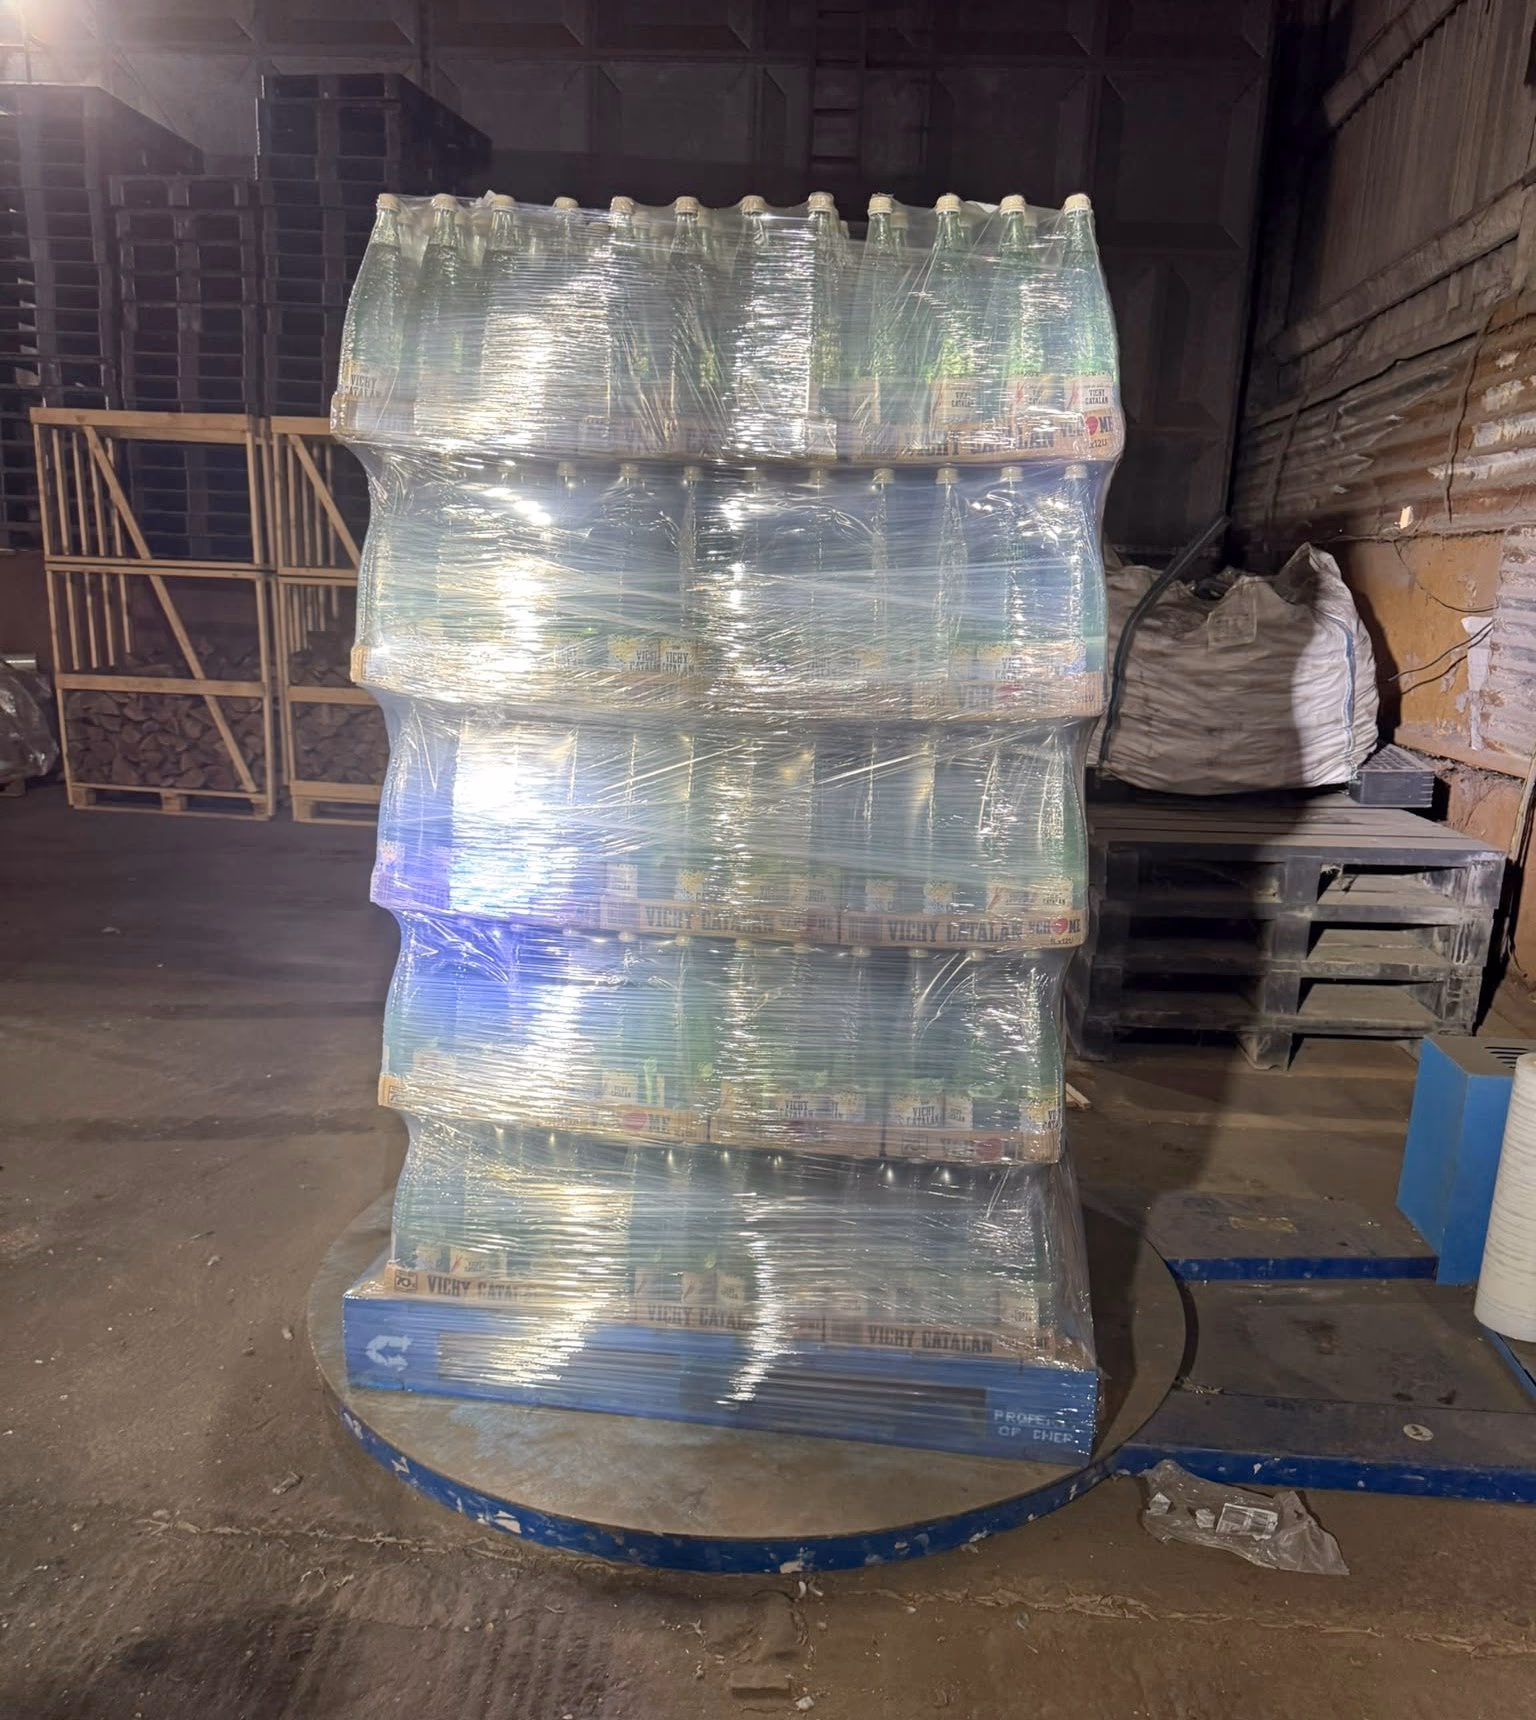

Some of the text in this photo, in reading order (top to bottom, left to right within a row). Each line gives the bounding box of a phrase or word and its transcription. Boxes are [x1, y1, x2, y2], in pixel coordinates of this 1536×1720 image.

[887, 919, 939, 942] VICHY
[428, 1274, 471, 1297] VICHY
[869, 1325, 915, 1347] VICHY
